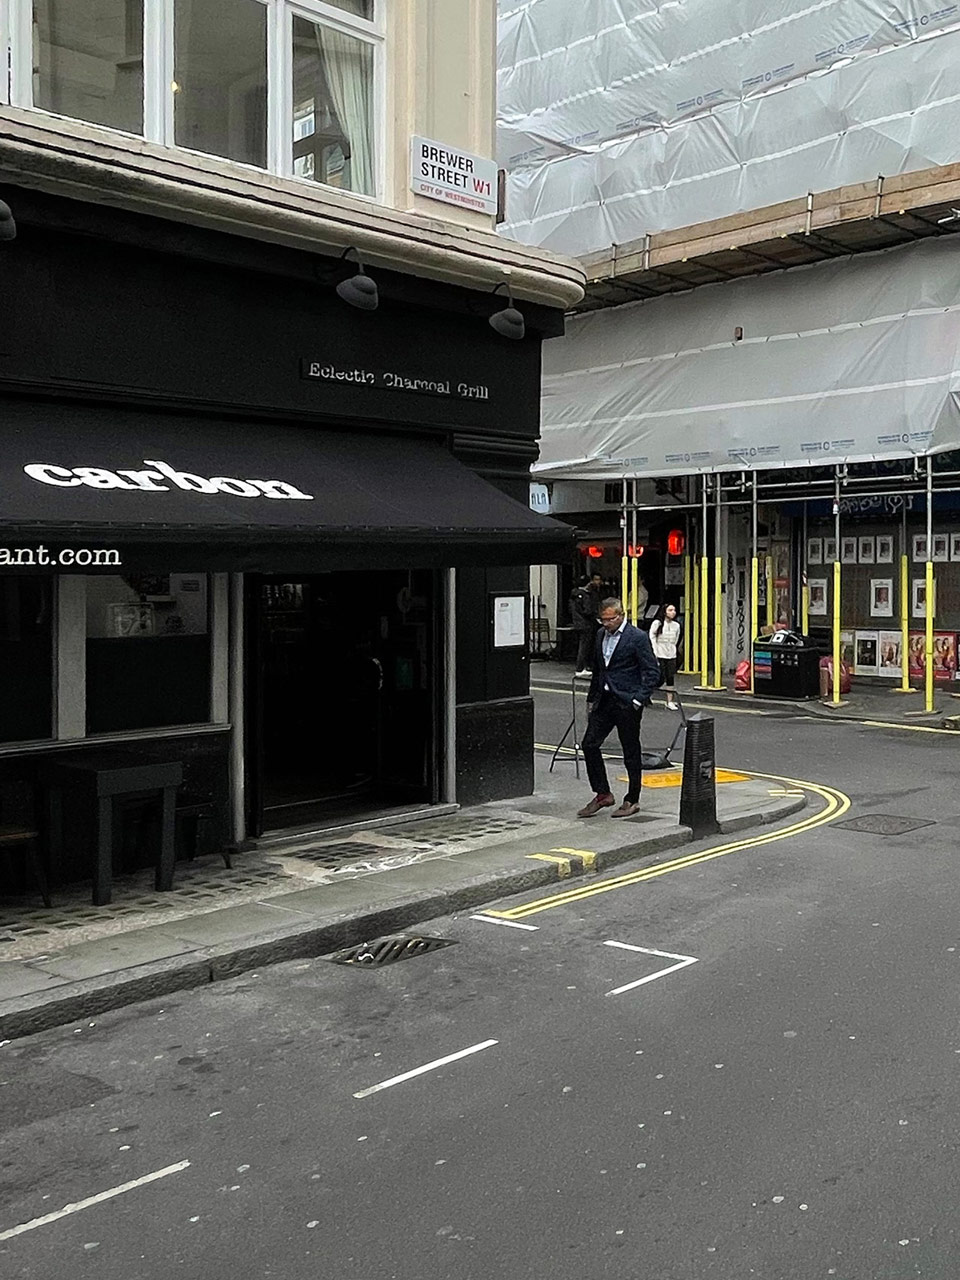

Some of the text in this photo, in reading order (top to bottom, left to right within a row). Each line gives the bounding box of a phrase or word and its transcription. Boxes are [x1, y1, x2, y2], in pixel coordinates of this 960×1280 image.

[421, 144, 473, 174] BREWER
[420, 183, 435, 194] CITY
[421, 162, 491, 196] STREET W1
[457, 383, 489, 400] Grill
[23, 459, 314, 500] carbon
[0, 545, 122, 565] ant.com
